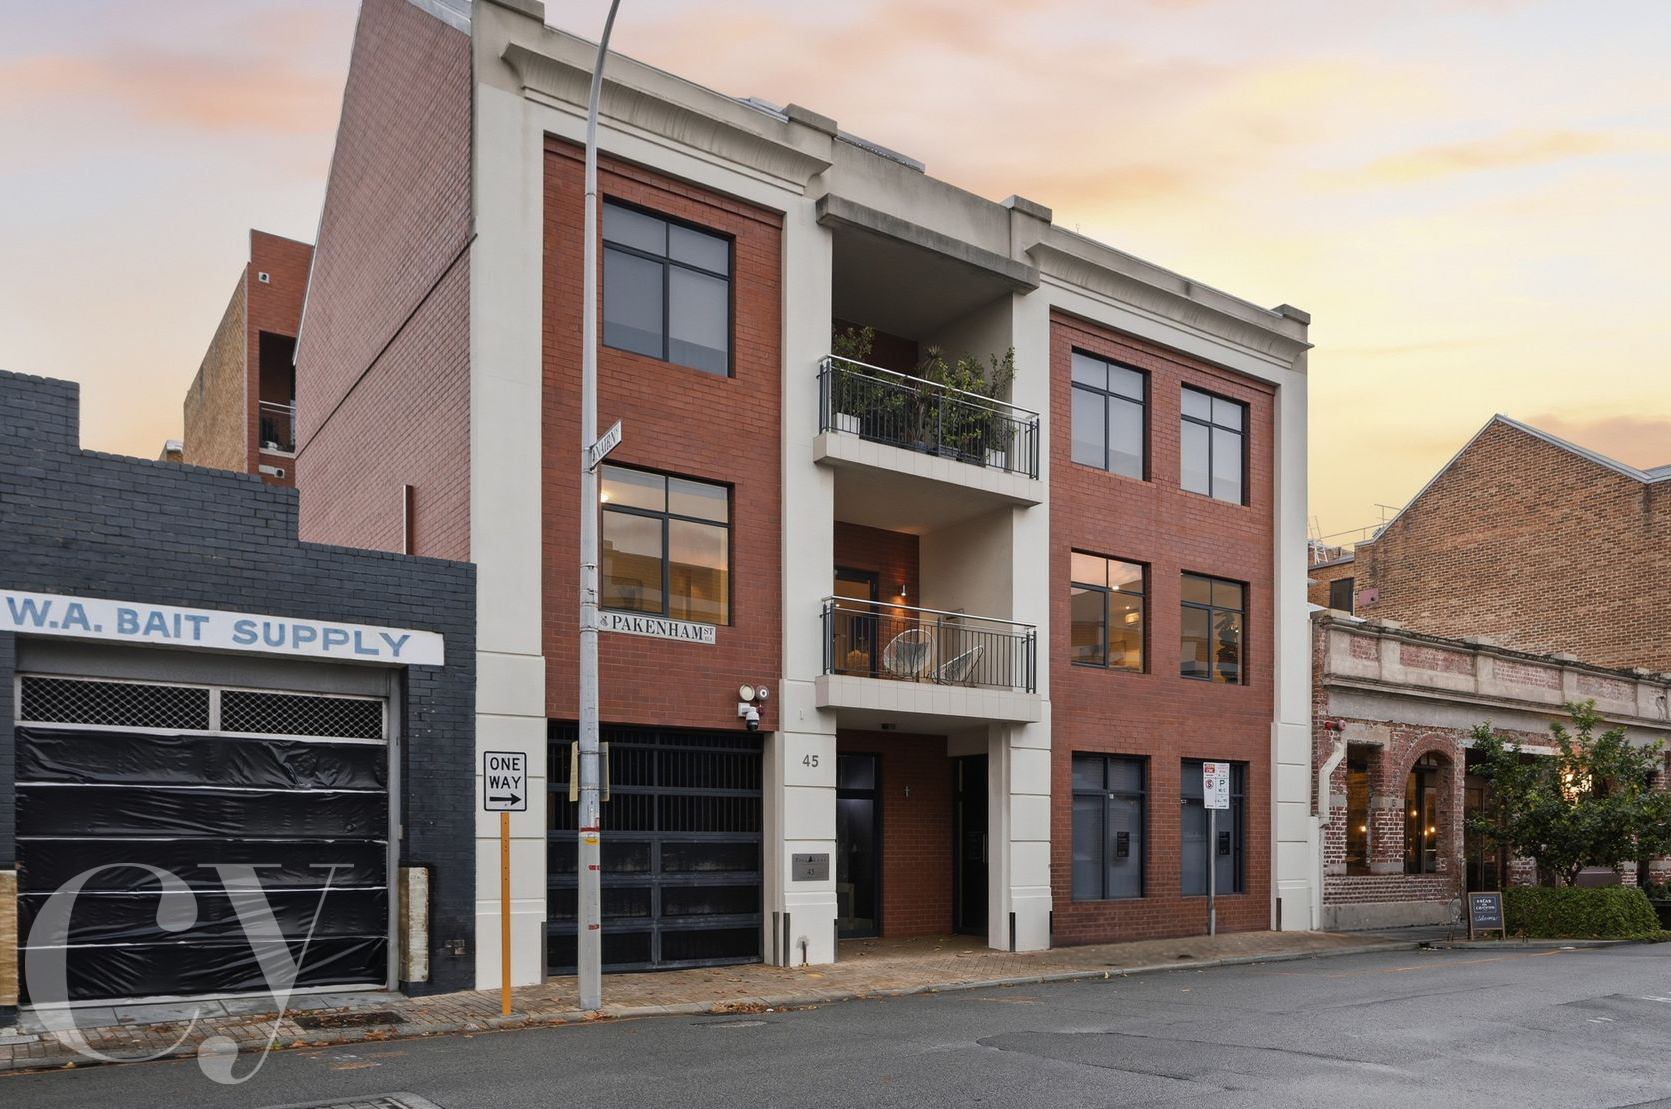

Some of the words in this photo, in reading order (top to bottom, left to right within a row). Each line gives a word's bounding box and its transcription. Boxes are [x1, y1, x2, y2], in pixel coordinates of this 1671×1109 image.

[6, 596, 103, 632] W.A.
[117, 607, 210, 640] BAIT
[232, 619, 411, 657] SUPPLY
[612, 615, 703, 640] PAKENHAM
[704, 627, 714, 635] ST
[490, 757, 520, 771] ONE
[802, 754, 819, 767] 45
[489, 776, 521, 789] WAY
